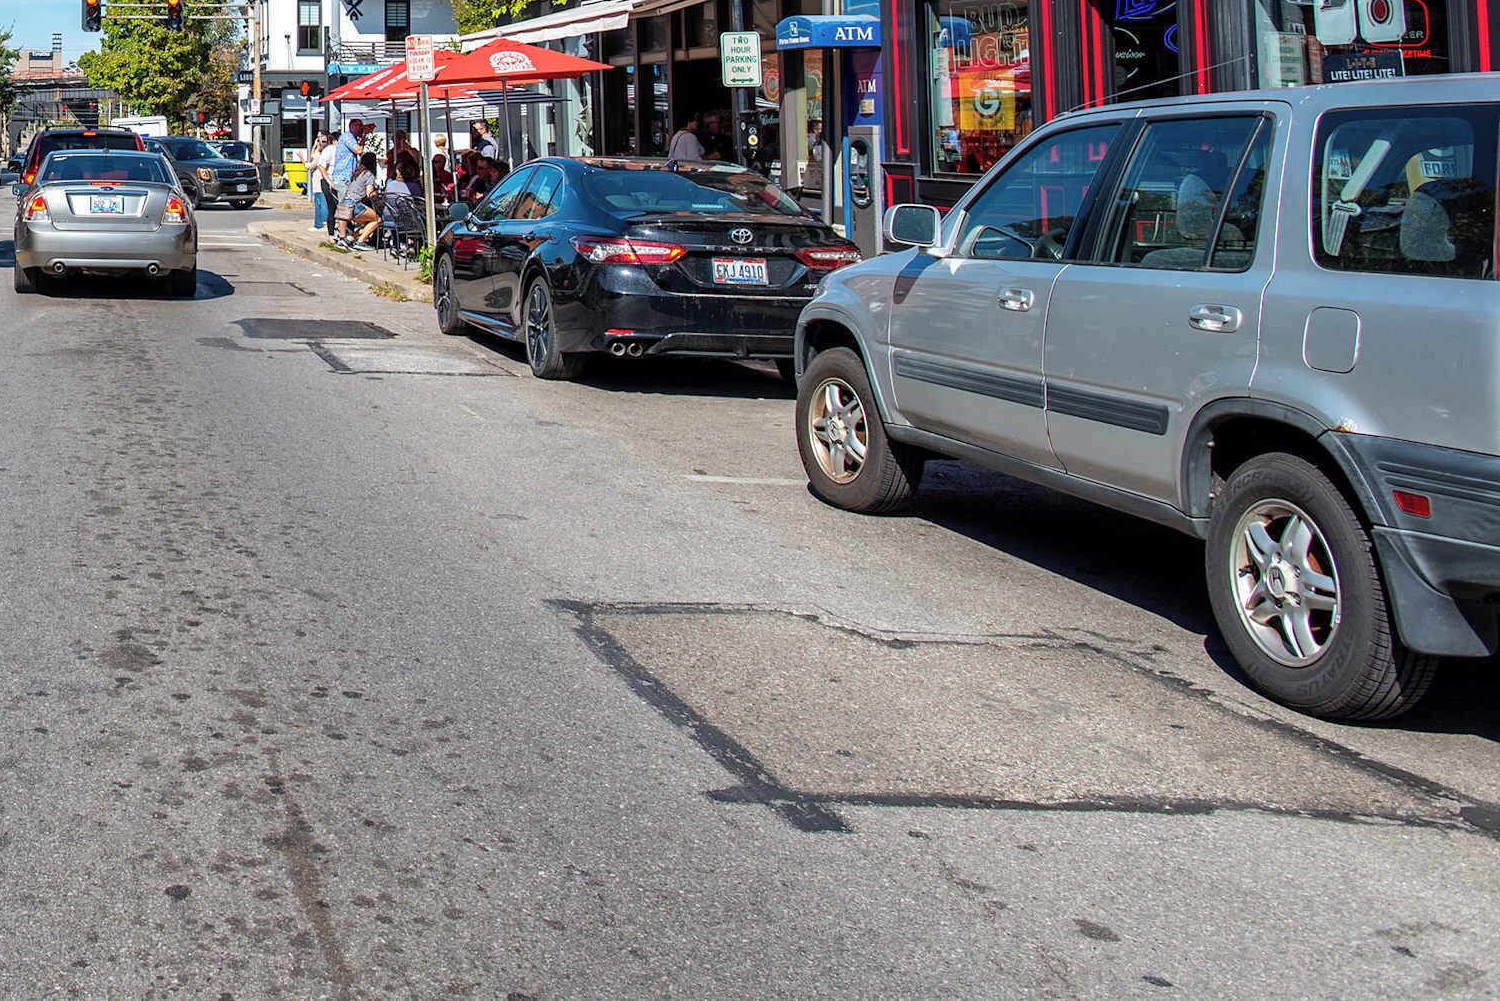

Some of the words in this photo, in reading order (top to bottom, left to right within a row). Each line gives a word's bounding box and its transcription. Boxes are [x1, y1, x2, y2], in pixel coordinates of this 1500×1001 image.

[835, 26, 874, 41] ATM
[730, 46, 752, 54] HOUR
[725, 55, 757, 64] PARKING
[731, 65, 752, 73] ONLY
[1330, 70, 1351, 81] LITE!
[1352, 69, 1373, 80] LITE!
[1374, 68, 1396, 80] LITE!
[857, 79, 877, 93] ATM
[716, 263, 736, 278] EKJ
